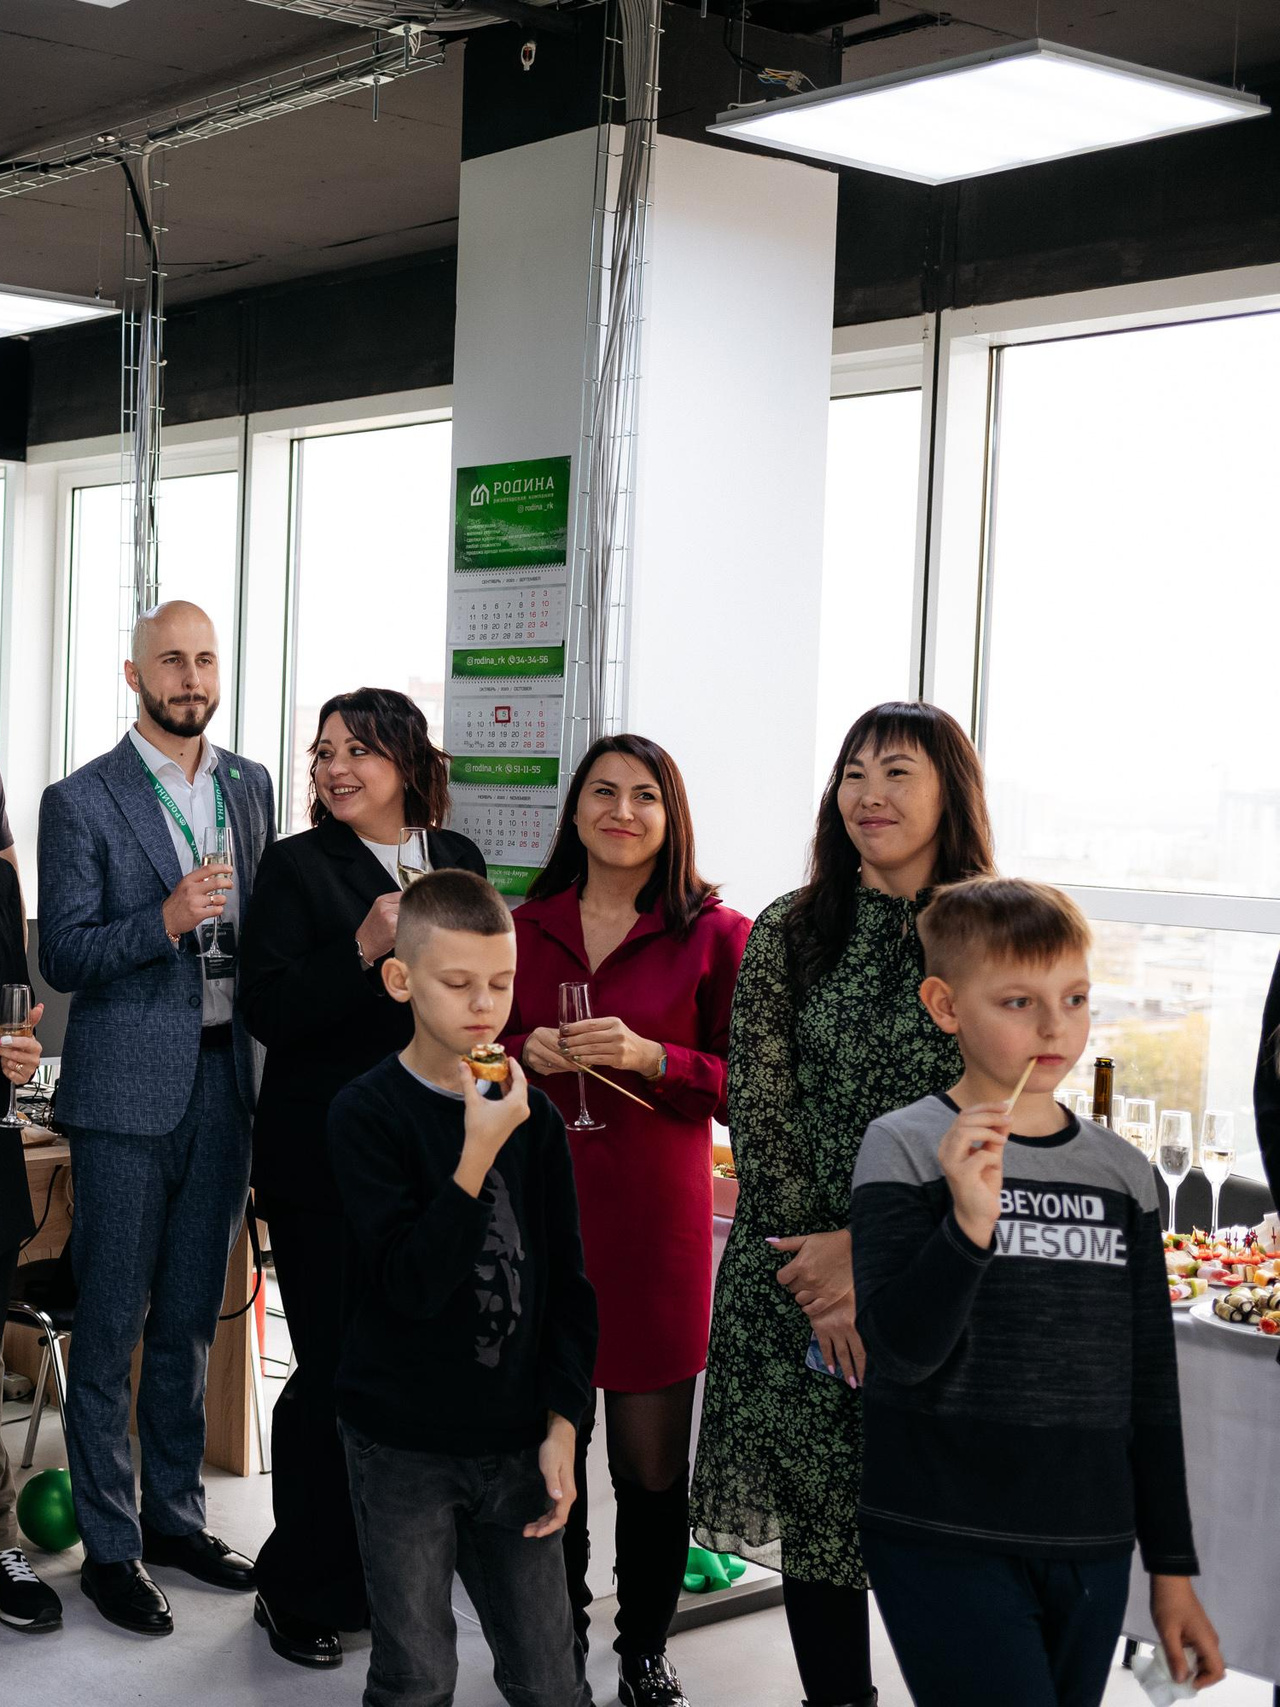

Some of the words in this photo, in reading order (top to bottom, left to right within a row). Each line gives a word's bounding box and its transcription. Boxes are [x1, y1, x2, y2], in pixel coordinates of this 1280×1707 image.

[493, 476, 554, 495] РОДИНА
[474, 656, 505, 665] rodina_rk
[472, 765, 503, 773] rodina_rk
[514, 765, 541, 773] 51-11-55
[154, 782, 182, 819] РОДИНА
[999, 1189, 1105, 1221] BEYOND
